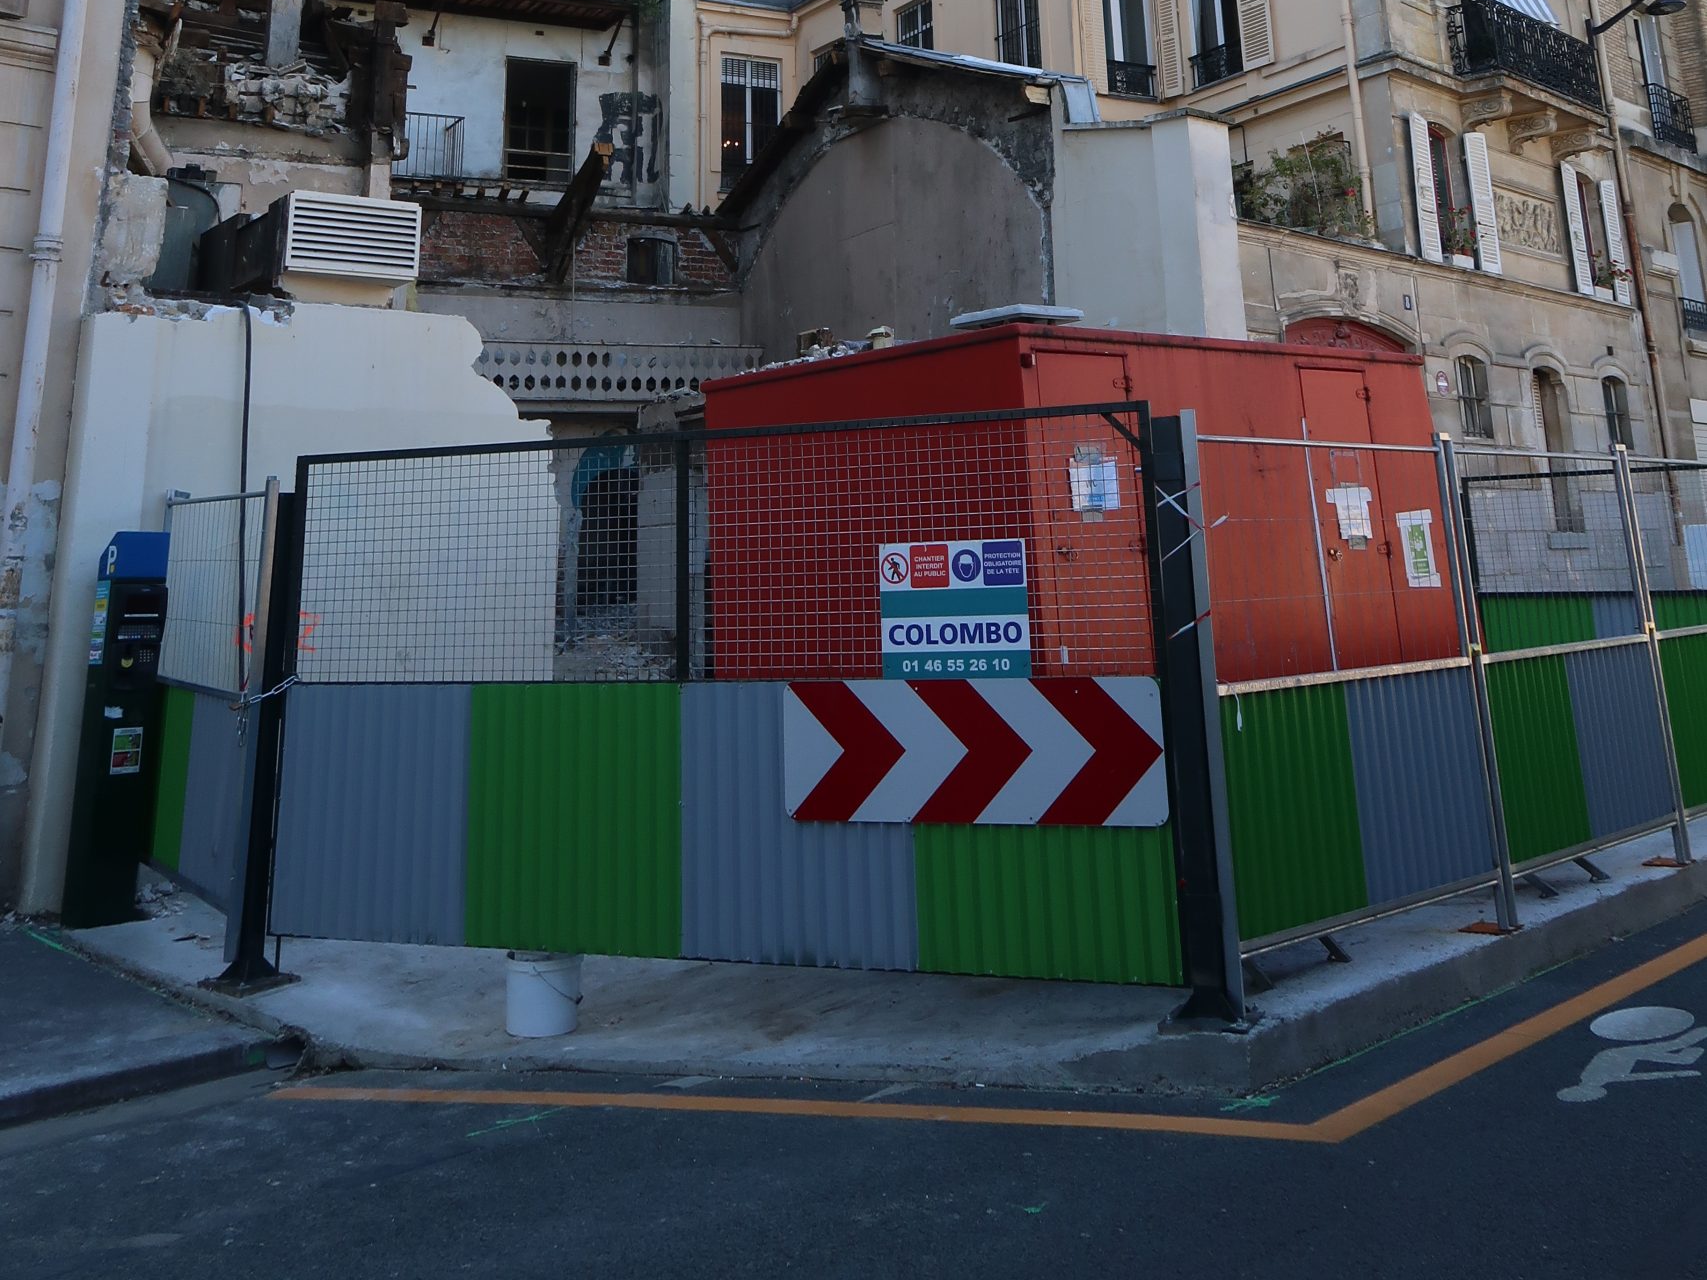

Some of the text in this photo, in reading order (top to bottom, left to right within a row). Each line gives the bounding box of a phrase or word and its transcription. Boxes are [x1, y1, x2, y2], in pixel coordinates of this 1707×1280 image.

[106, 545, 117, 575] P
[889, 622, 1022, 646] COLOMBO
[902, 659, 1010, 672] 01 46 55 26 10
